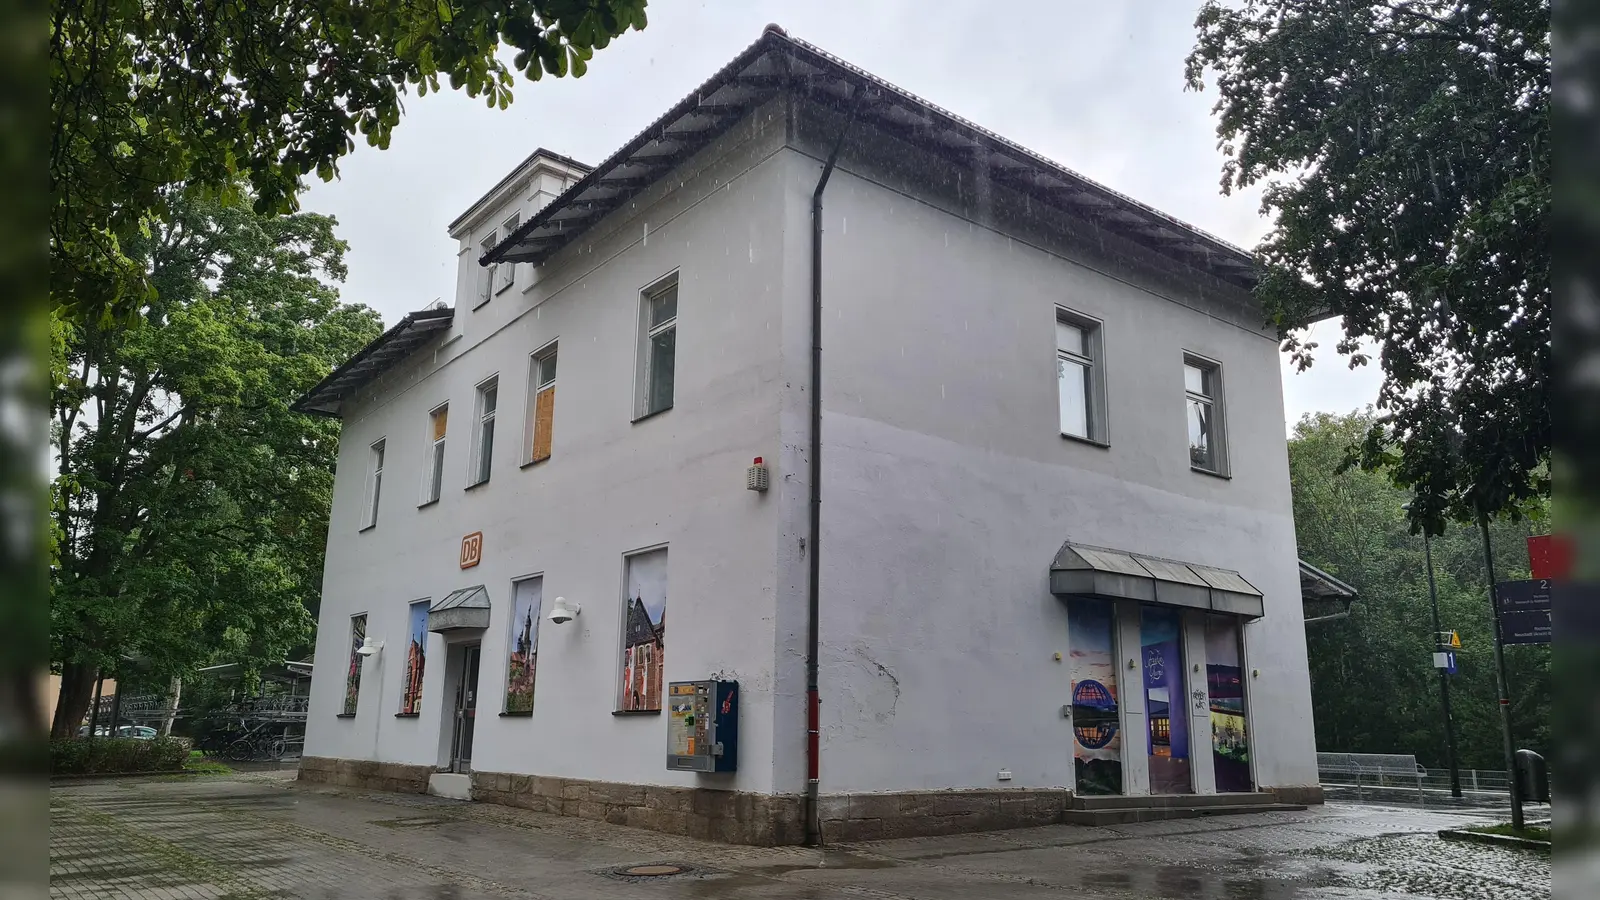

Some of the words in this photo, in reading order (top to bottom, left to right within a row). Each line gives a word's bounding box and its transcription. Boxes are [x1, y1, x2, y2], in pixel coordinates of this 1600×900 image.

[462, 537, 478, 563] DB
[1546, 612, 1552, 622] 1
[1448, 652, 1455, 668] 1
